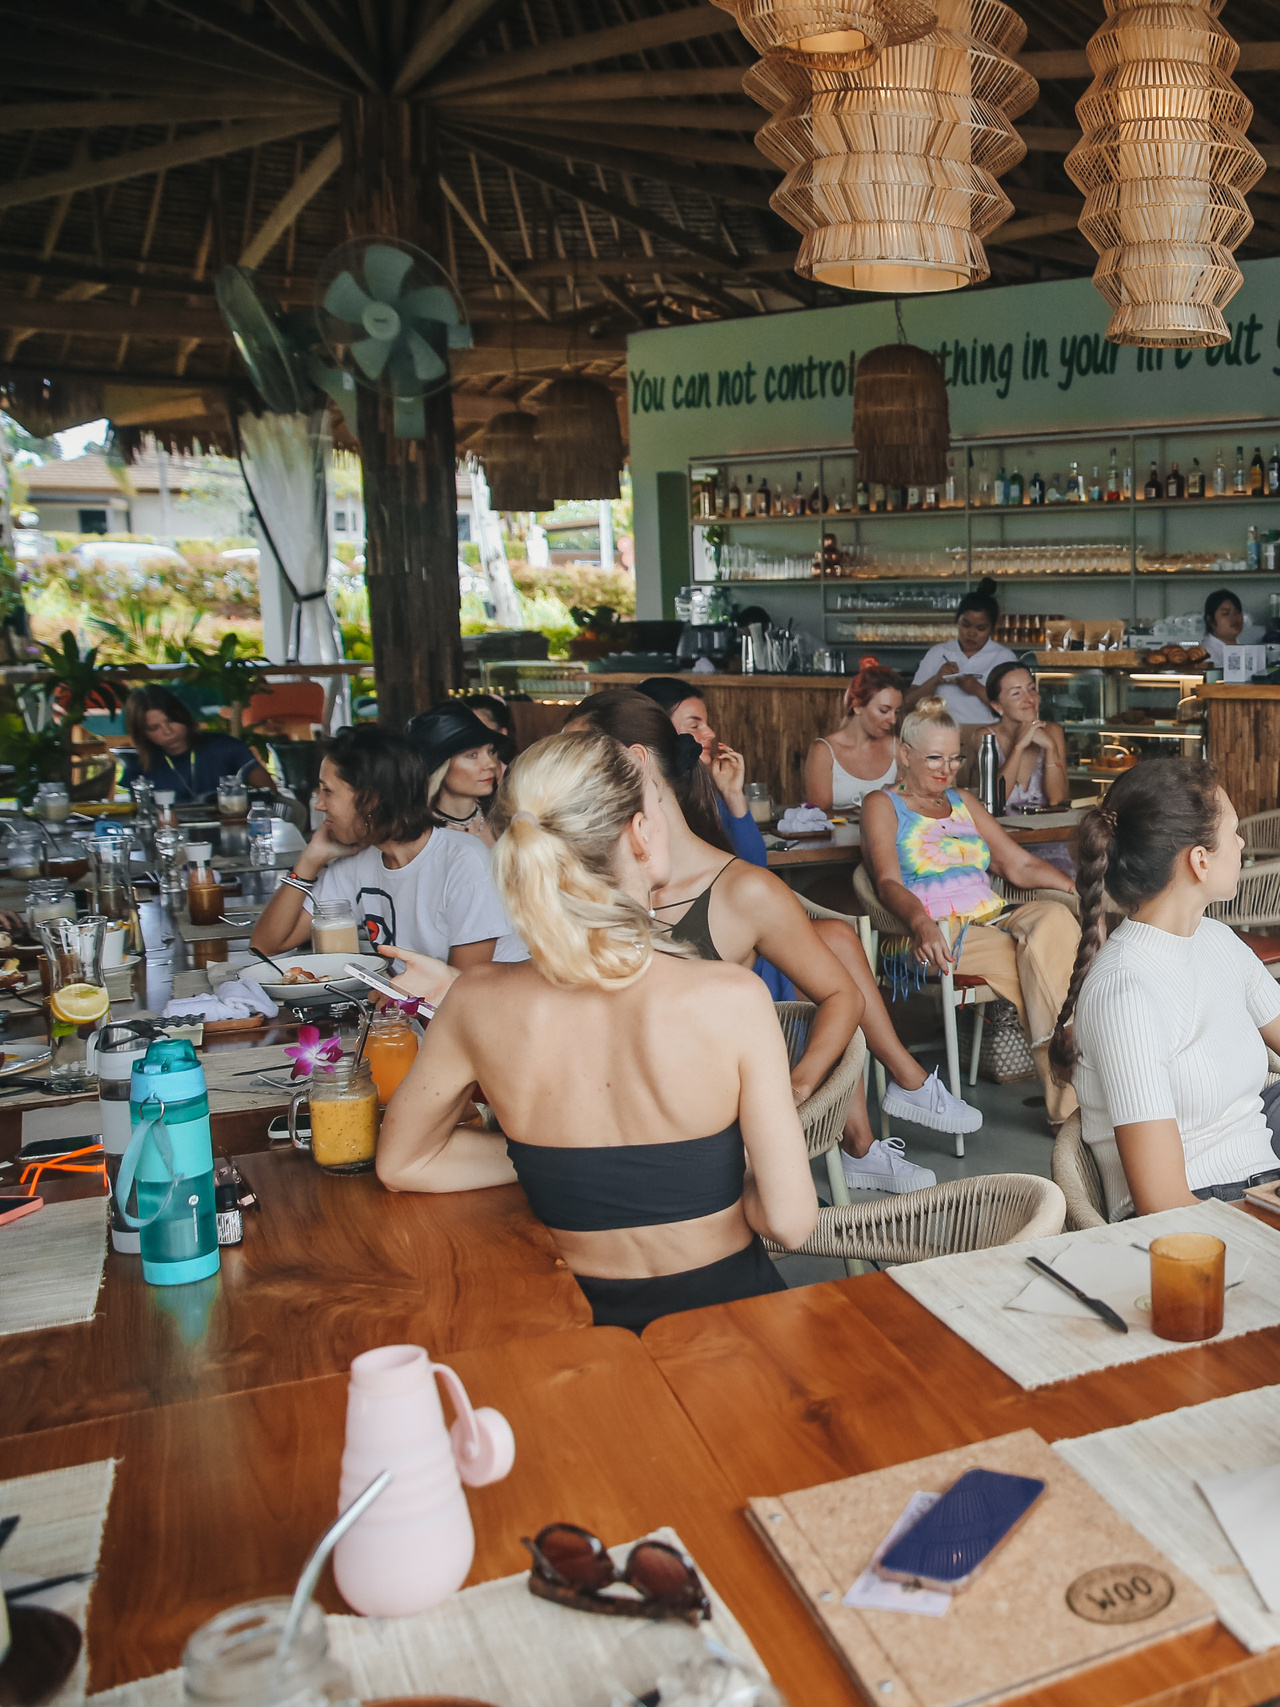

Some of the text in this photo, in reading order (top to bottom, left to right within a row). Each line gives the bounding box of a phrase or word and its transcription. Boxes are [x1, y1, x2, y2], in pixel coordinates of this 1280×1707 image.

[630, 369, 666, 415] You
[672, 371, 711, 409] can
[717, 361, 757, 407] not
[764, 350, 856, 404] control
[936, 336, 1014, 398] thing
[1022, 331, 1049, 380] in
[1058, 332, 1119, 391] your
[1085, 1575, 1152, 1610] WOO
